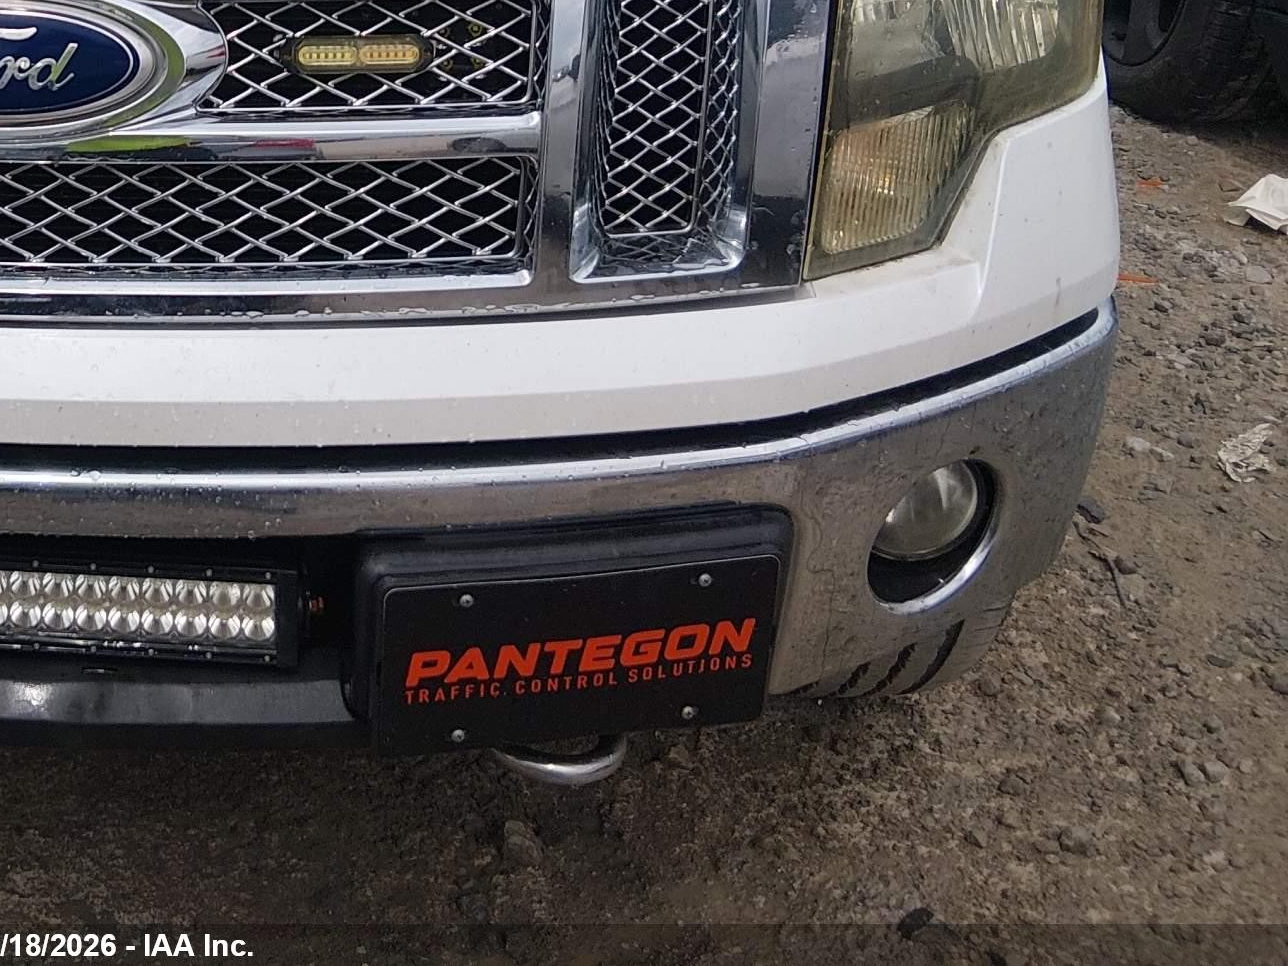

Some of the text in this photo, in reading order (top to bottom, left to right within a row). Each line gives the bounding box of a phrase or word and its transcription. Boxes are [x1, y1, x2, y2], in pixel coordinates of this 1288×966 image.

[404, 617, 756, 688] PANTEGON
[404, 653, 753, 705] TRAFFIC CONTROL SOLUTIONS
